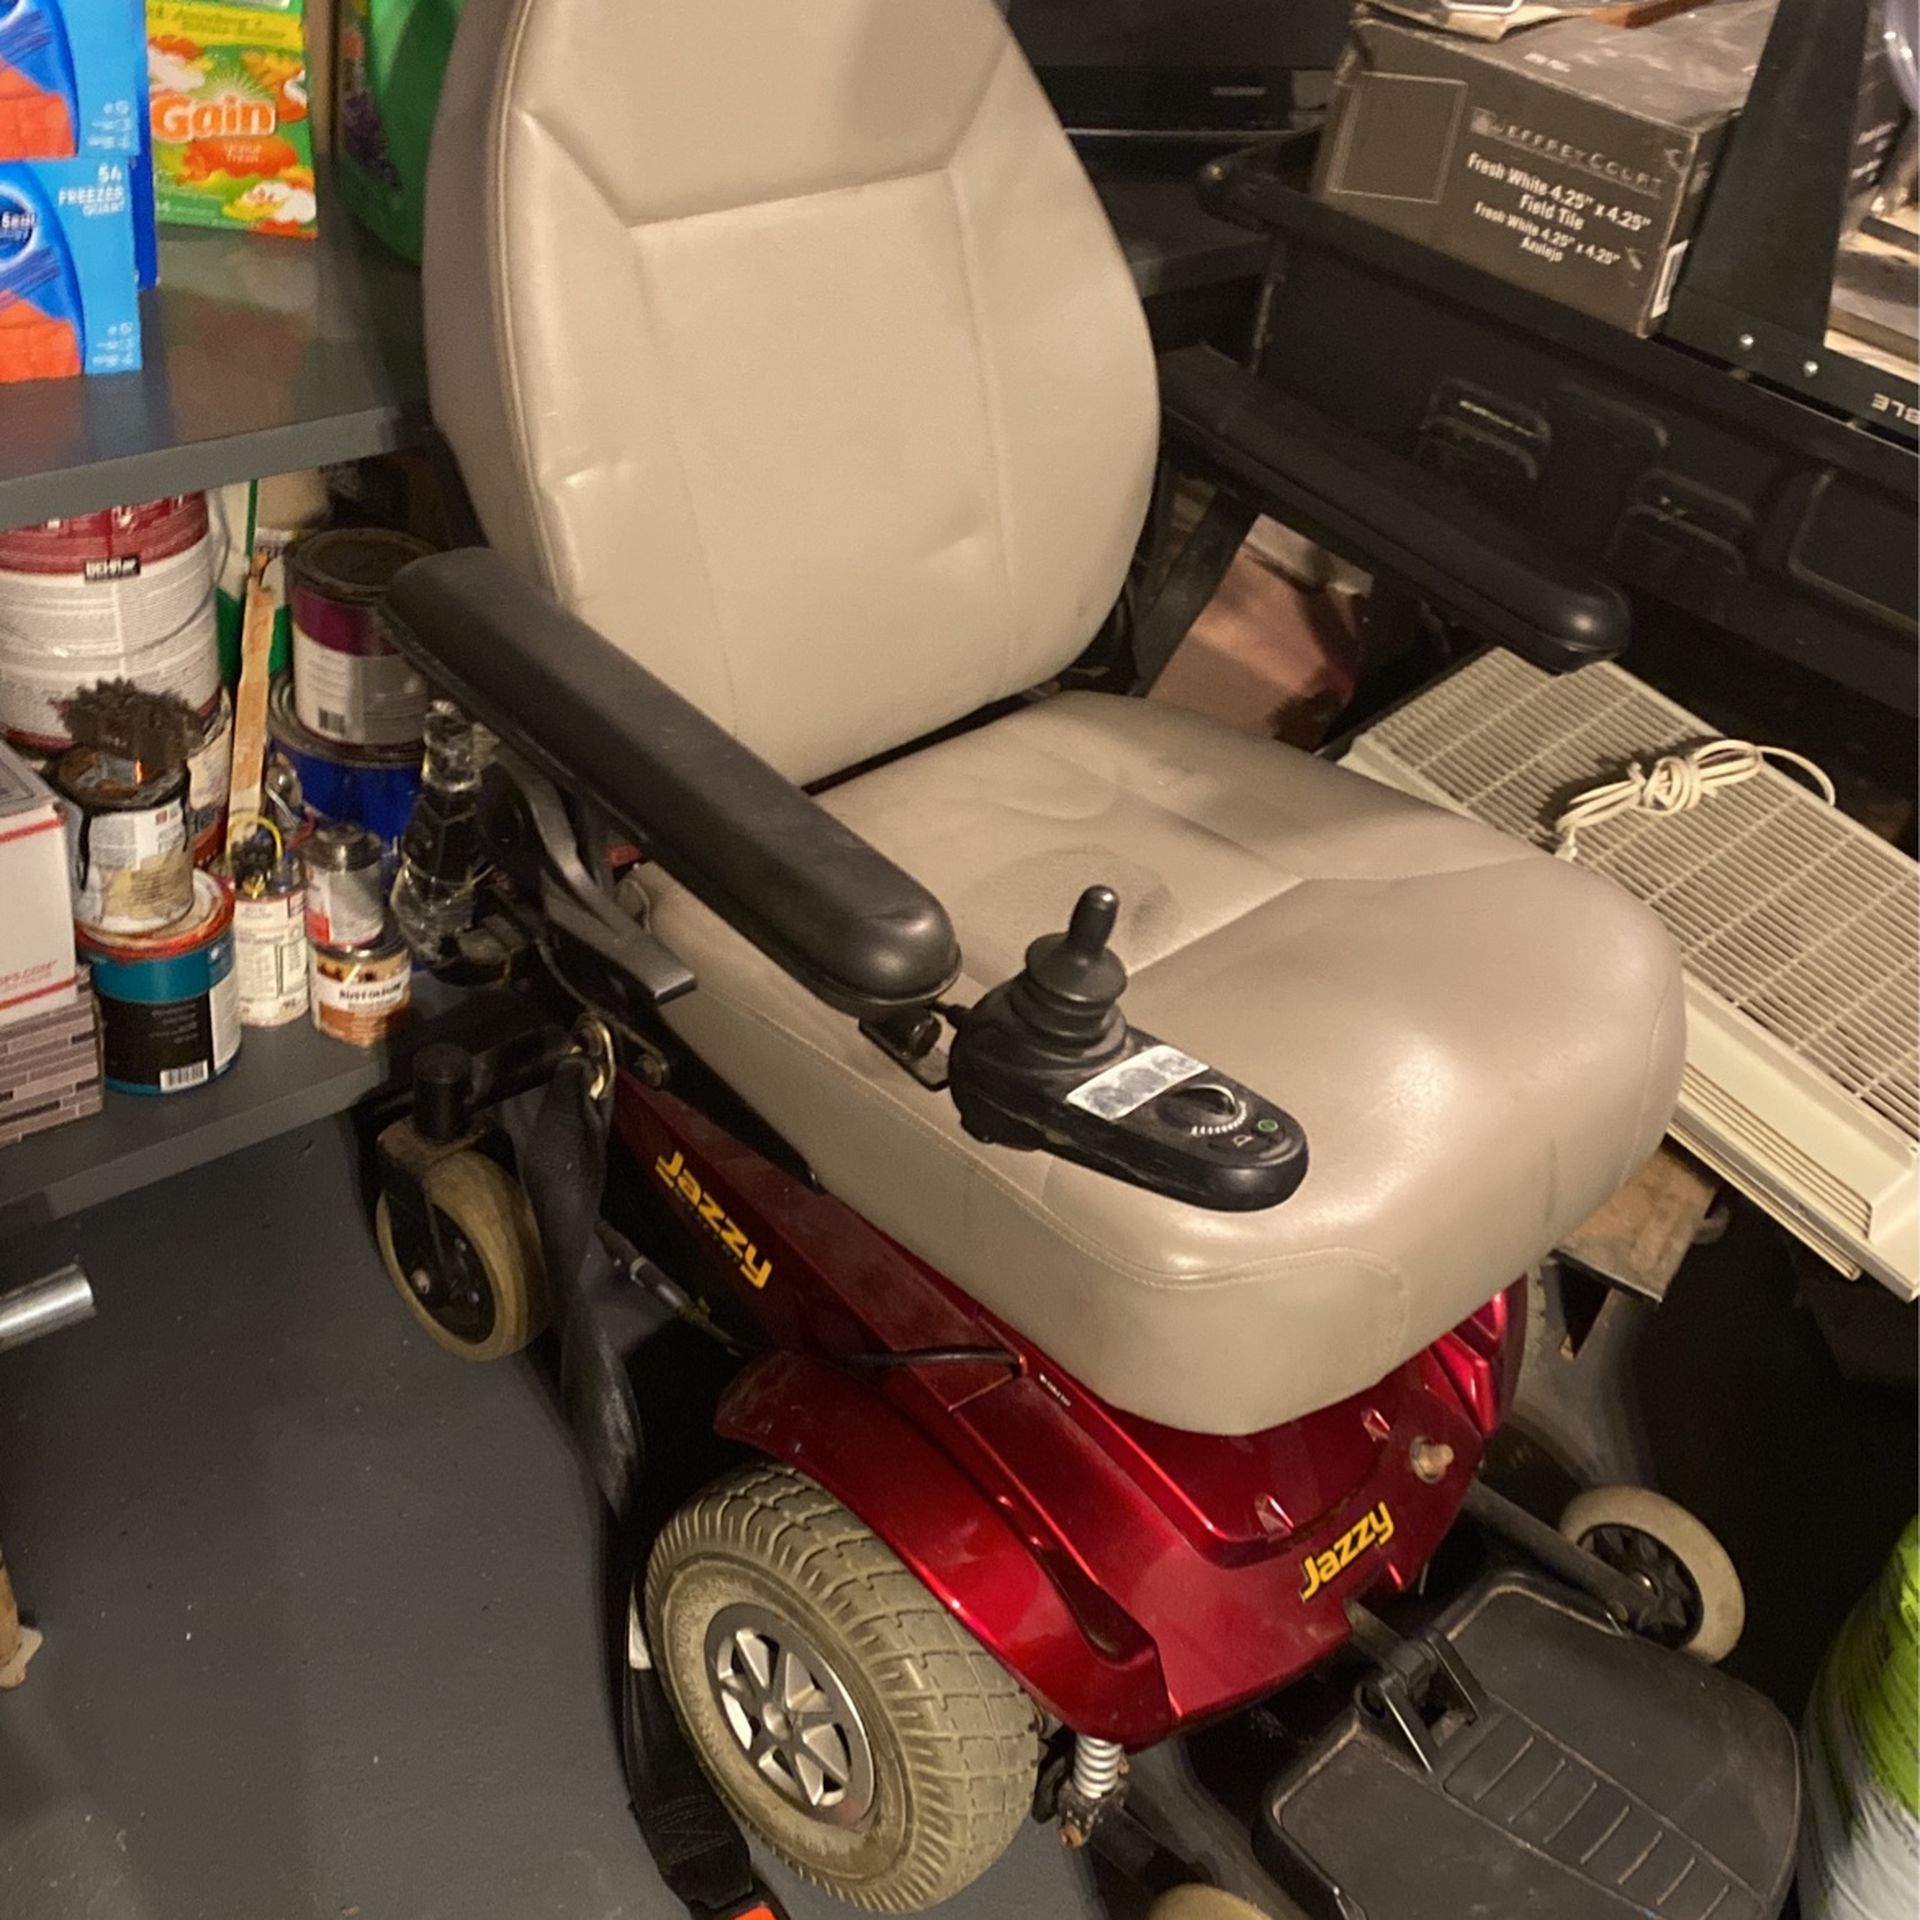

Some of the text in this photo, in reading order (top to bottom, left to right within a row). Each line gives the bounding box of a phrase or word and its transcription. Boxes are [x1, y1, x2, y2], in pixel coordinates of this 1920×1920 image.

[149, 95, 276, 143] Gain
[58, 185, 125, 207] FREEZER
[1467, 152, 1652, 231] Fresh White 4.25" x 4.25"
[1519, 193, 1585, 231] Field Tile
[1473, 201, 1507, 224] Fresh
[1507, 214, 1540, 237] White
[1576, 243, 1585, 254] x
[1520, 237, 1564, 263] Azulejo
[655, 1151, 772, 1289] Jazzy
[1303, 1500, 1394, 1600] Jazzy
